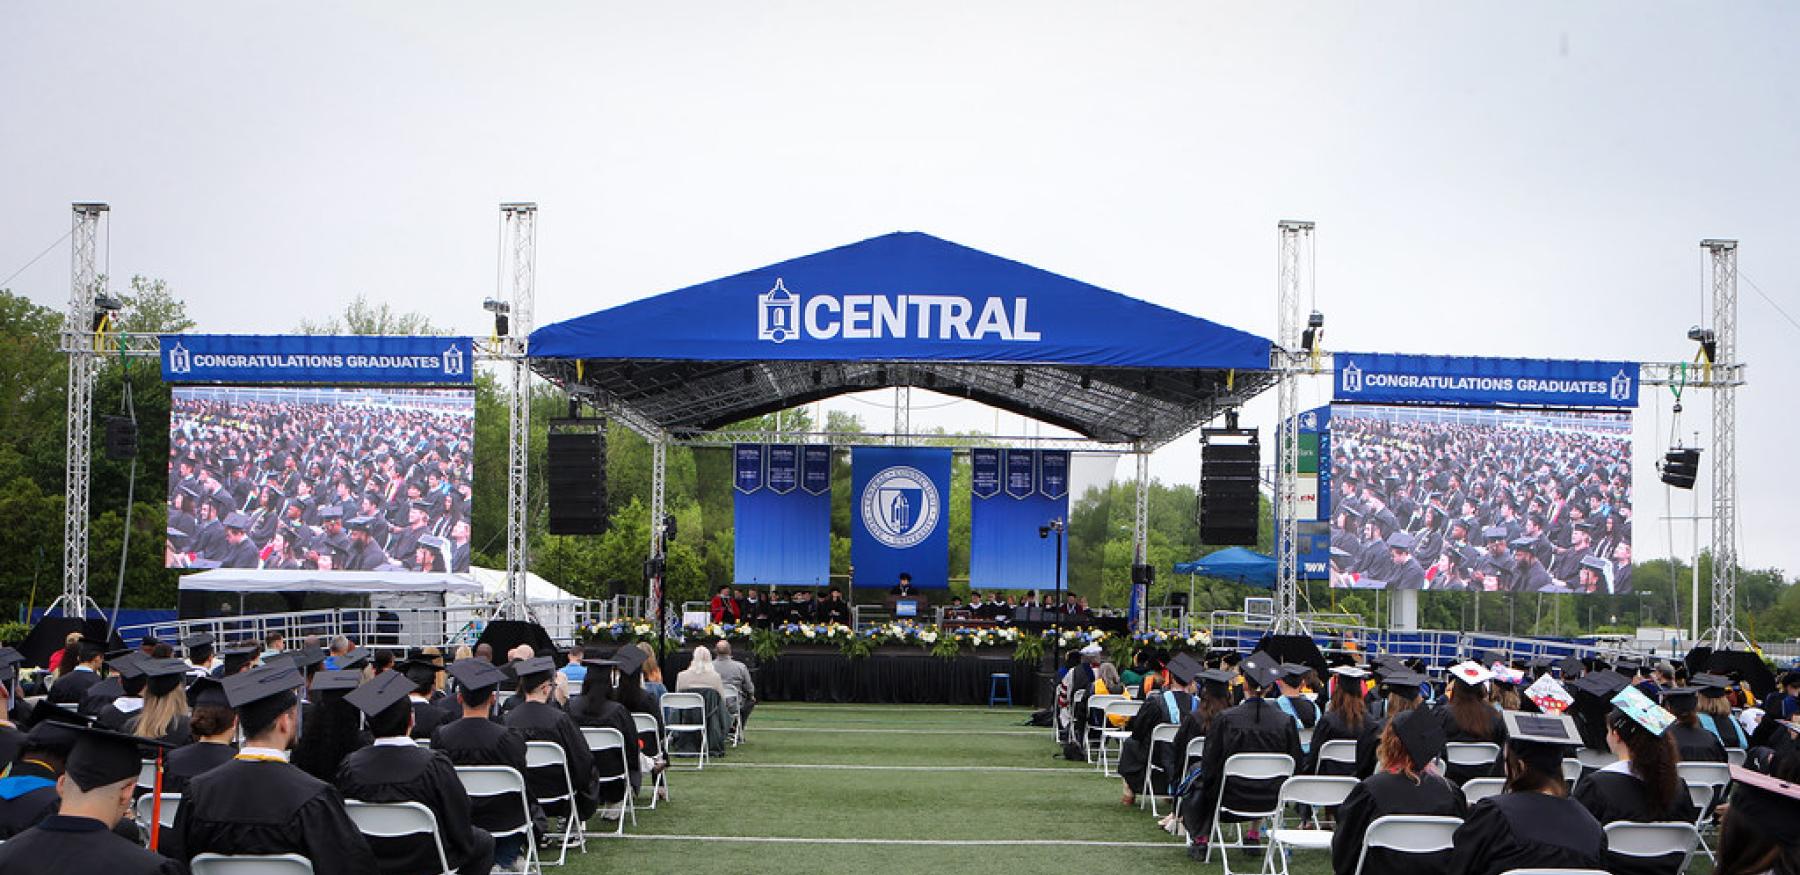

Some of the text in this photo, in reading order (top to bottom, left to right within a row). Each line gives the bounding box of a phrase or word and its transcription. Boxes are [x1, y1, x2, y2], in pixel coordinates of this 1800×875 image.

[804, 294, 1041, 342] CENTRAL
[193, 354, 440, 369] CONGRATULATIONS GRADUATES
[1365, 373, 1607, 394] CONGRATULATIONS GRADUATES
